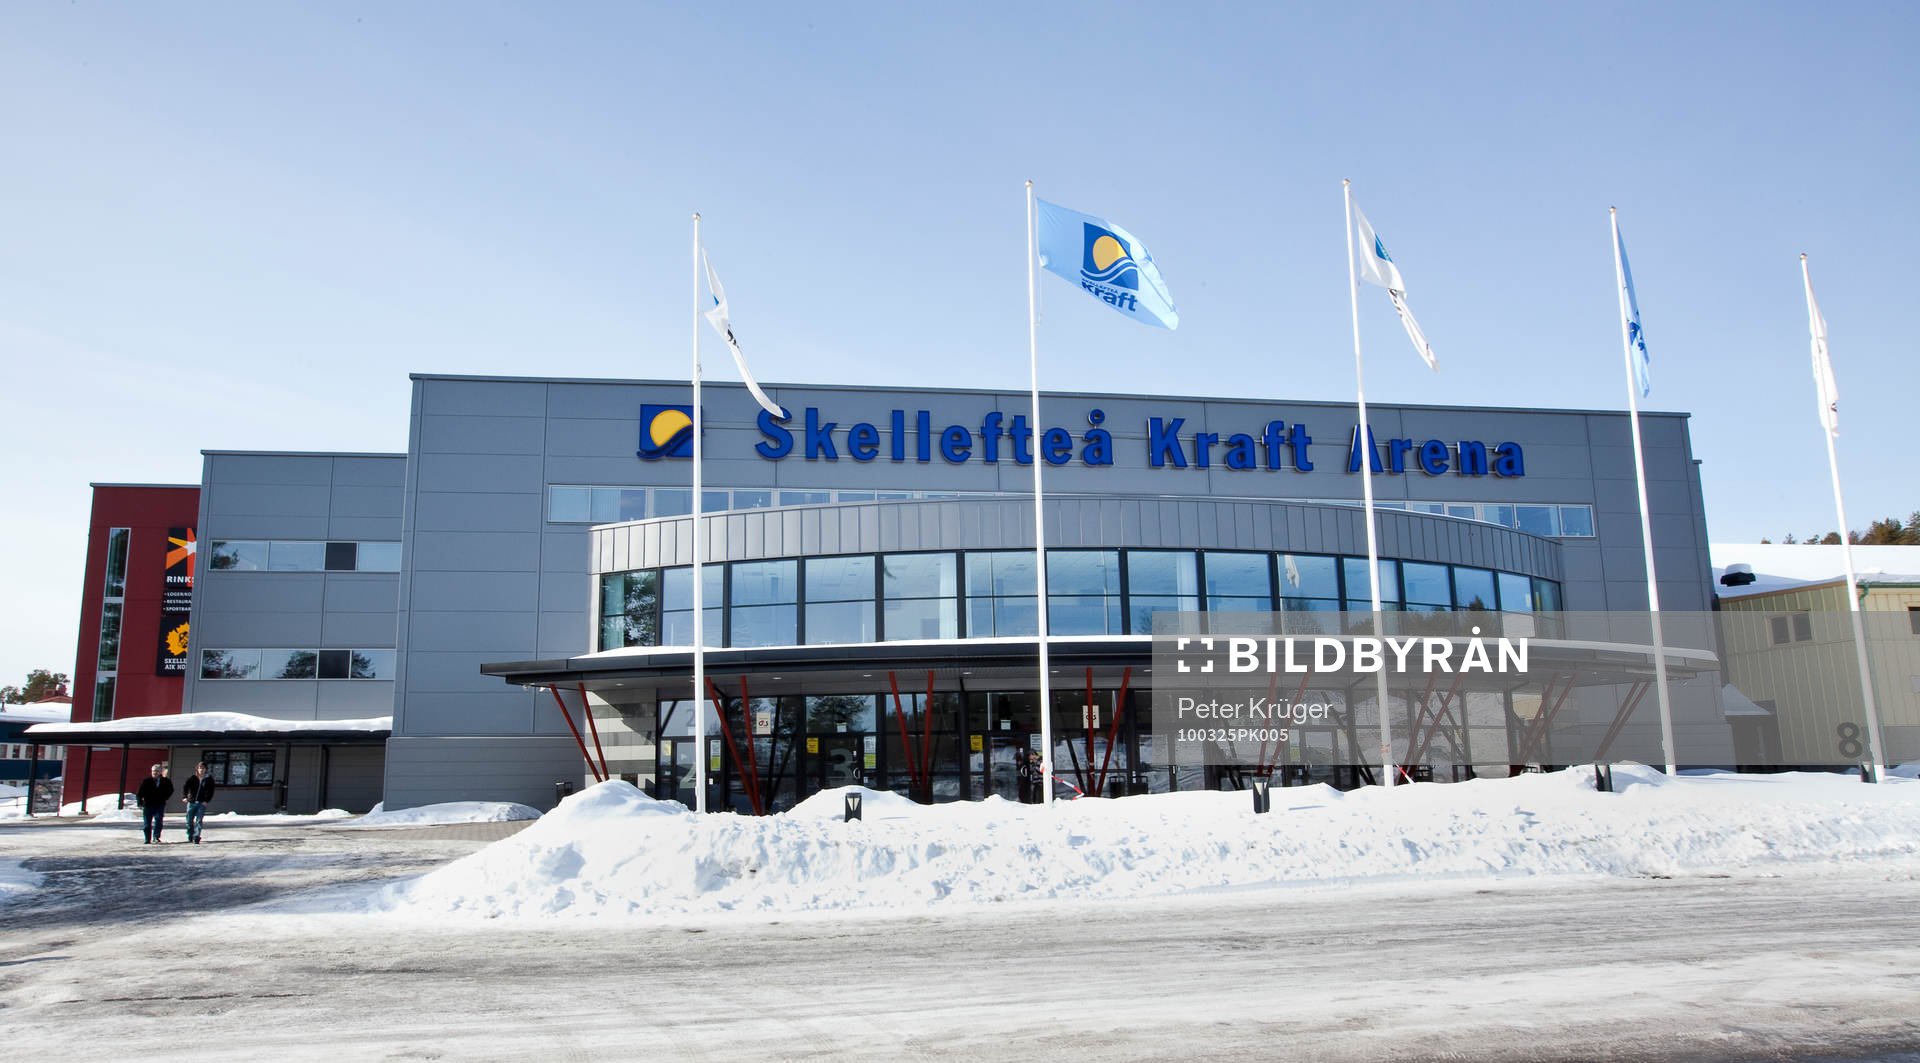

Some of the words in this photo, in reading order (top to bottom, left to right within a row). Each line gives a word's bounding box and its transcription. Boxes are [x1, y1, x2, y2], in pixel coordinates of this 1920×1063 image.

[754, 406, 1114, 467] Skellefteå
[1147, 416, 1314, 472] Kraft
[1347, 423, 1526, 477] Arena
[1837, 722, 1863, 758] 8
